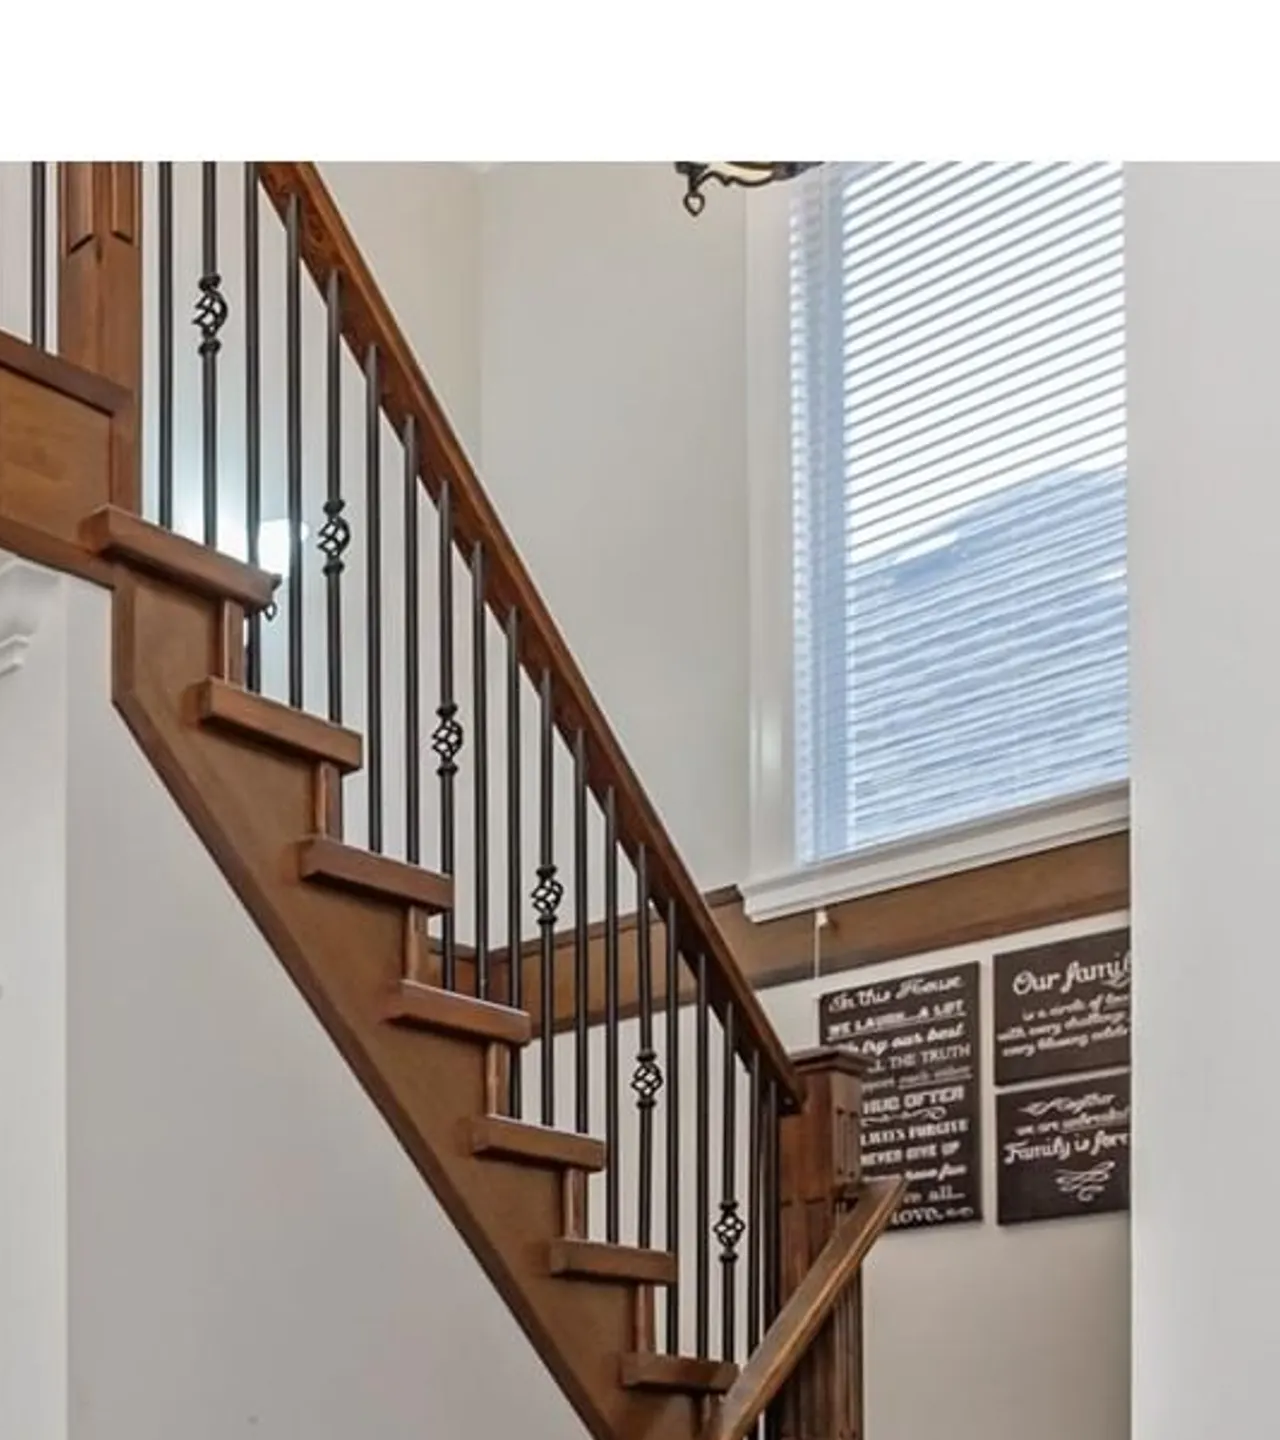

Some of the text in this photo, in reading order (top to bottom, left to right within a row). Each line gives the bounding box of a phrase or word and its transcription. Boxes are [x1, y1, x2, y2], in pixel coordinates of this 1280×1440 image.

[1012, 969, 1061, 996] Our
[856, 988, 891, 1006] this
[926, 1022, 965, 1043] best
[920, 1043, 972, 1064] TRUTH
[1003, 1136, 1070, 1165] Family
